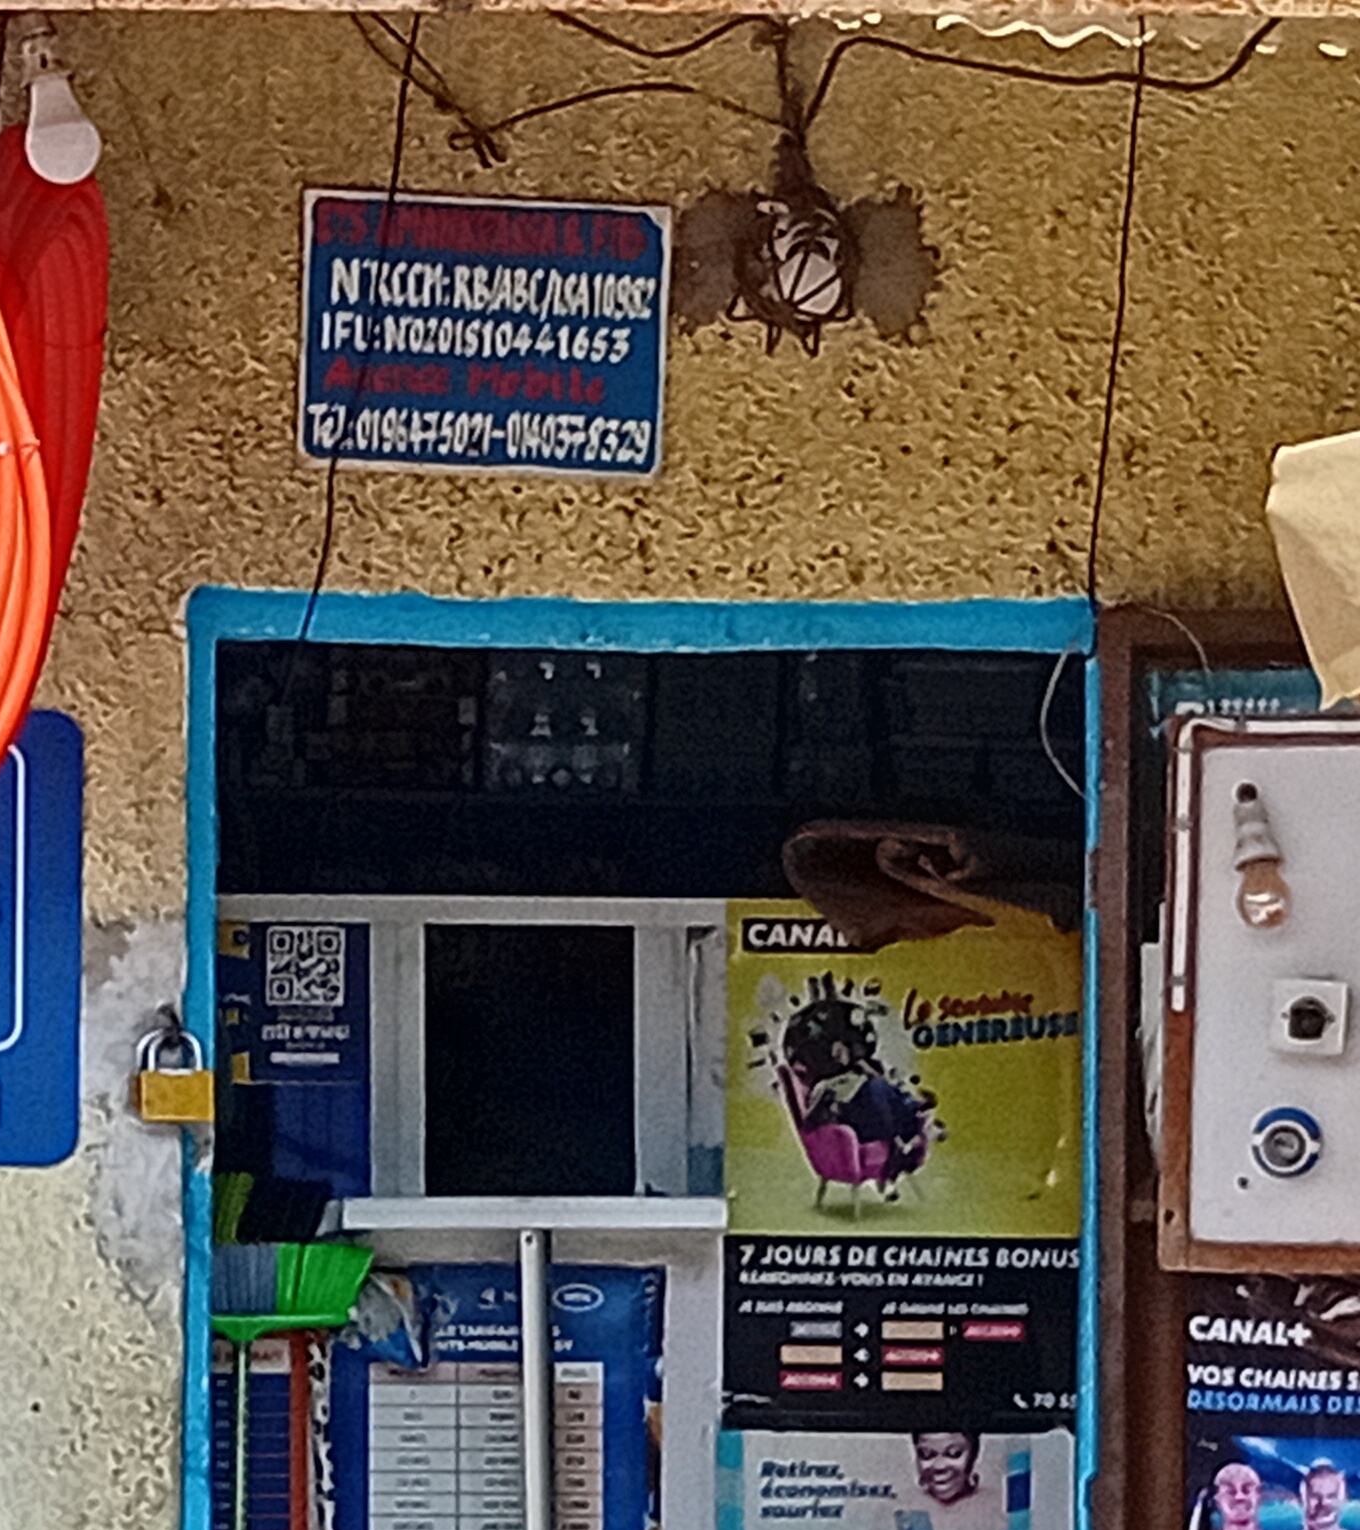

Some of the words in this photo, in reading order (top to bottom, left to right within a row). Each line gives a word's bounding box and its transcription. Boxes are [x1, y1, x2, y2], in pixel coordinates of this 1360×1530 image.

[740, 1244, 756, 1266] 7
[760, 1244, 842, 1266] JOURS
[847, 1245, 878, 1267] DE
[995, 1247, 1080, 1268] BONUS
[1188, 1316, 1312, 1346] CANAL+
[1187, 1364, 1235, 1386] VOS
[1239, 1367, 1342, 1389] CHAINES
